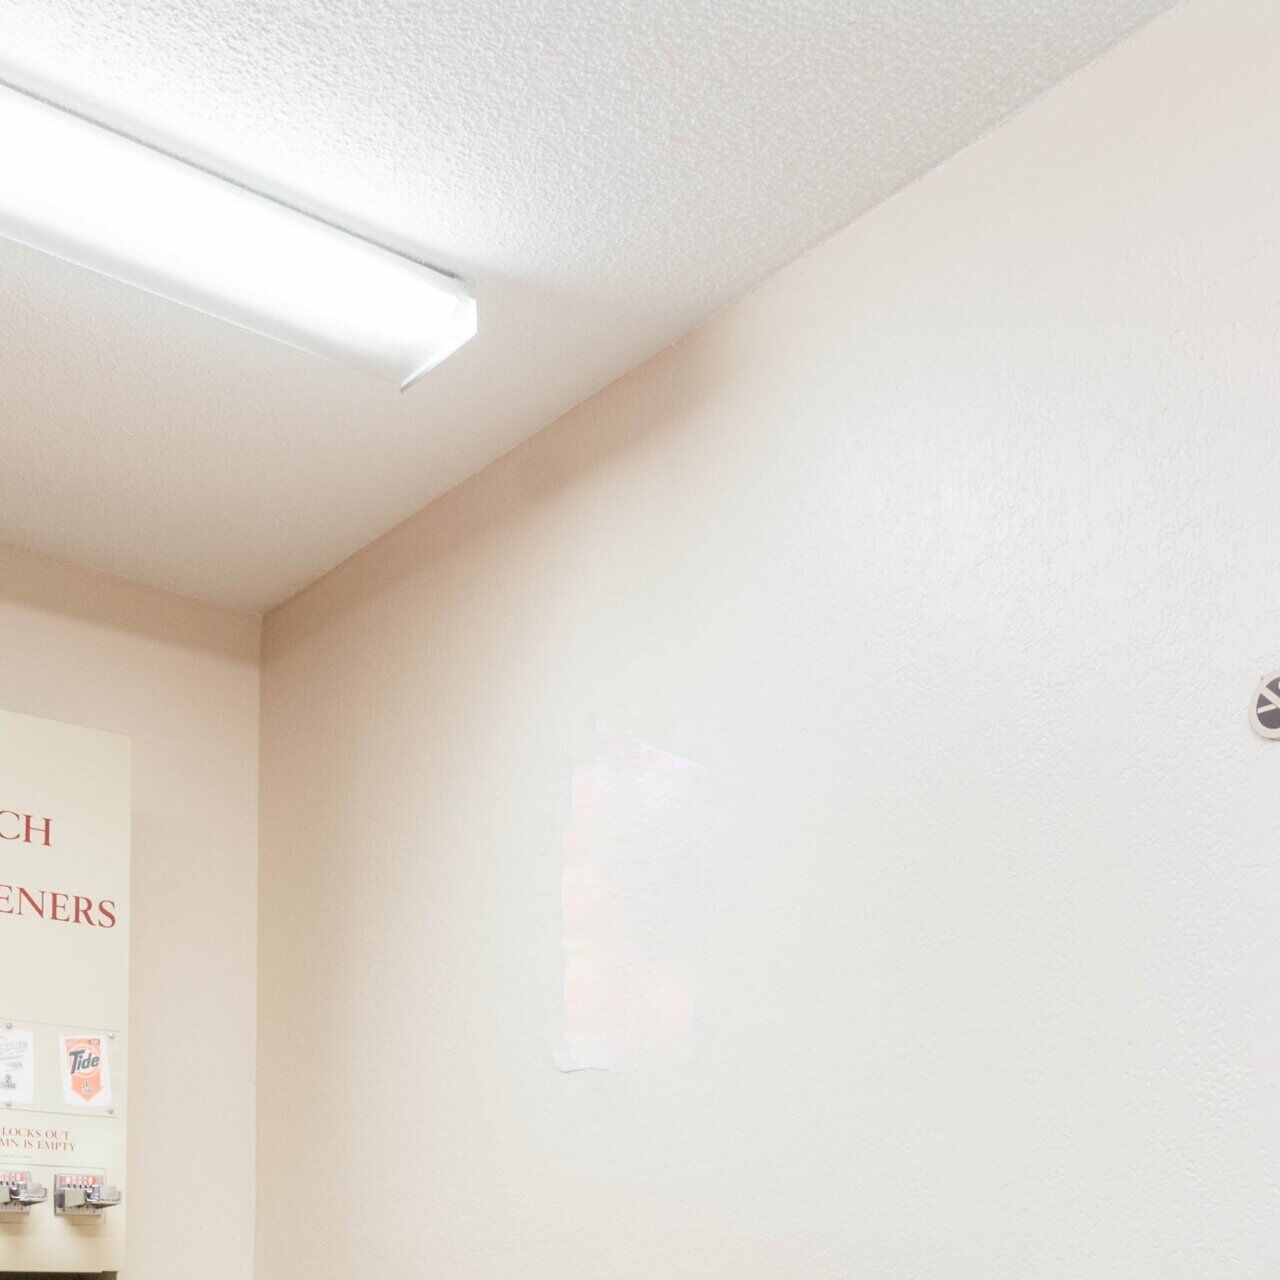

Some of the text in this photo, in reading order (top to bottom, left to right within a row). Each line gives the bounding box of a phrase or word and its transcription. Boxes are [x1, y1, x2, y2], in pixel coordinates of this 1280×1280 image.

[69, 1049, 100, 1075] Tide
[2, 1126, 42, 1138] LOCKS
[45, 1129, 71, 1141] OUT
[24, 1138, 34, 1149] IS
[37, 1140, 76, 1152] EMPTY
